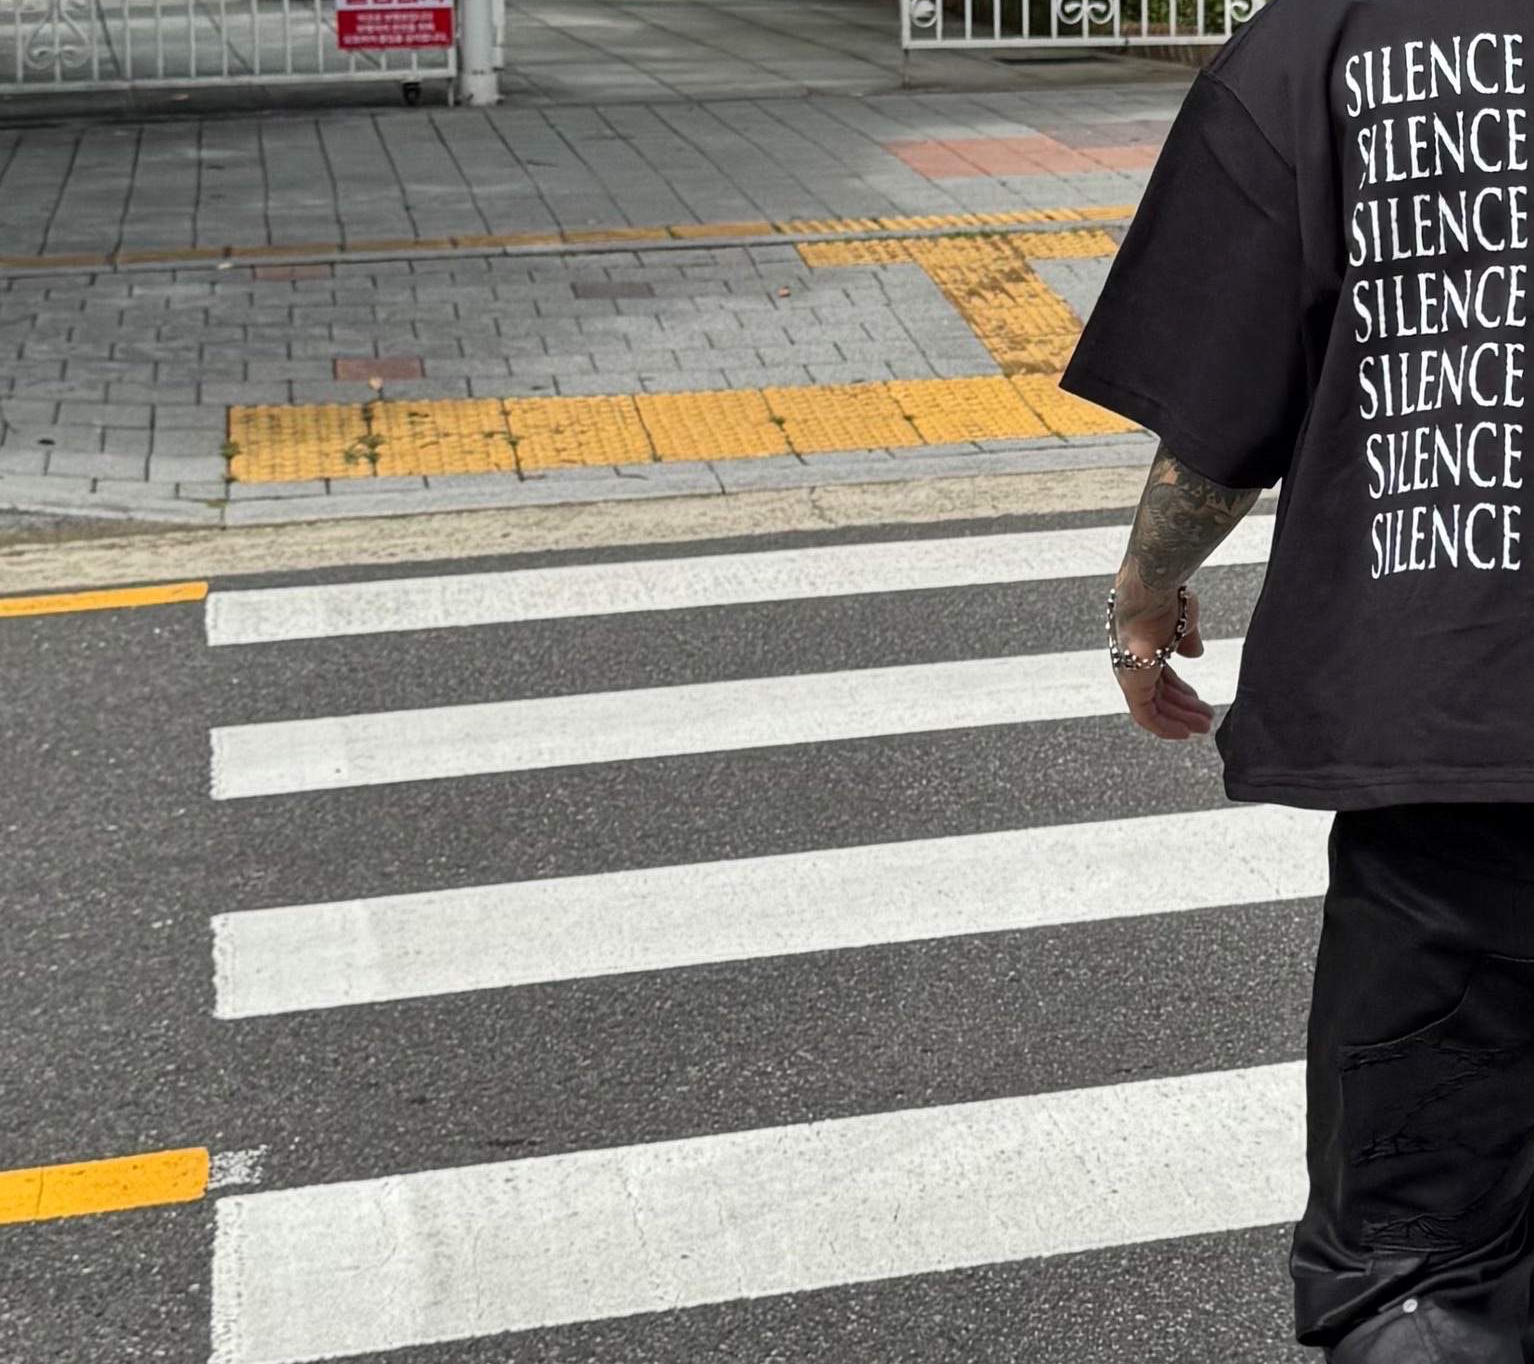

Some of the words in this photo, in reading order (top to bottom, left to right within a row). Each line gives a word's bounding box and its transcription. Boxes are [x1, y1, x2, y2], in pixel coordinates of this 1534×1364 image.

[1344, 32, 1526, 118] SILENCE
[1357, 107, 1528, 190] SILENCE
[1349, 185, 1528, 267] SILENCE
[1352, 264, 1527, 344] SILENCE
[1359, 341, 1525, 420] SILENCE
[1366, 421, 1523, 500] SILENCE
[1371, 502, 1522, 580] SILENCE
